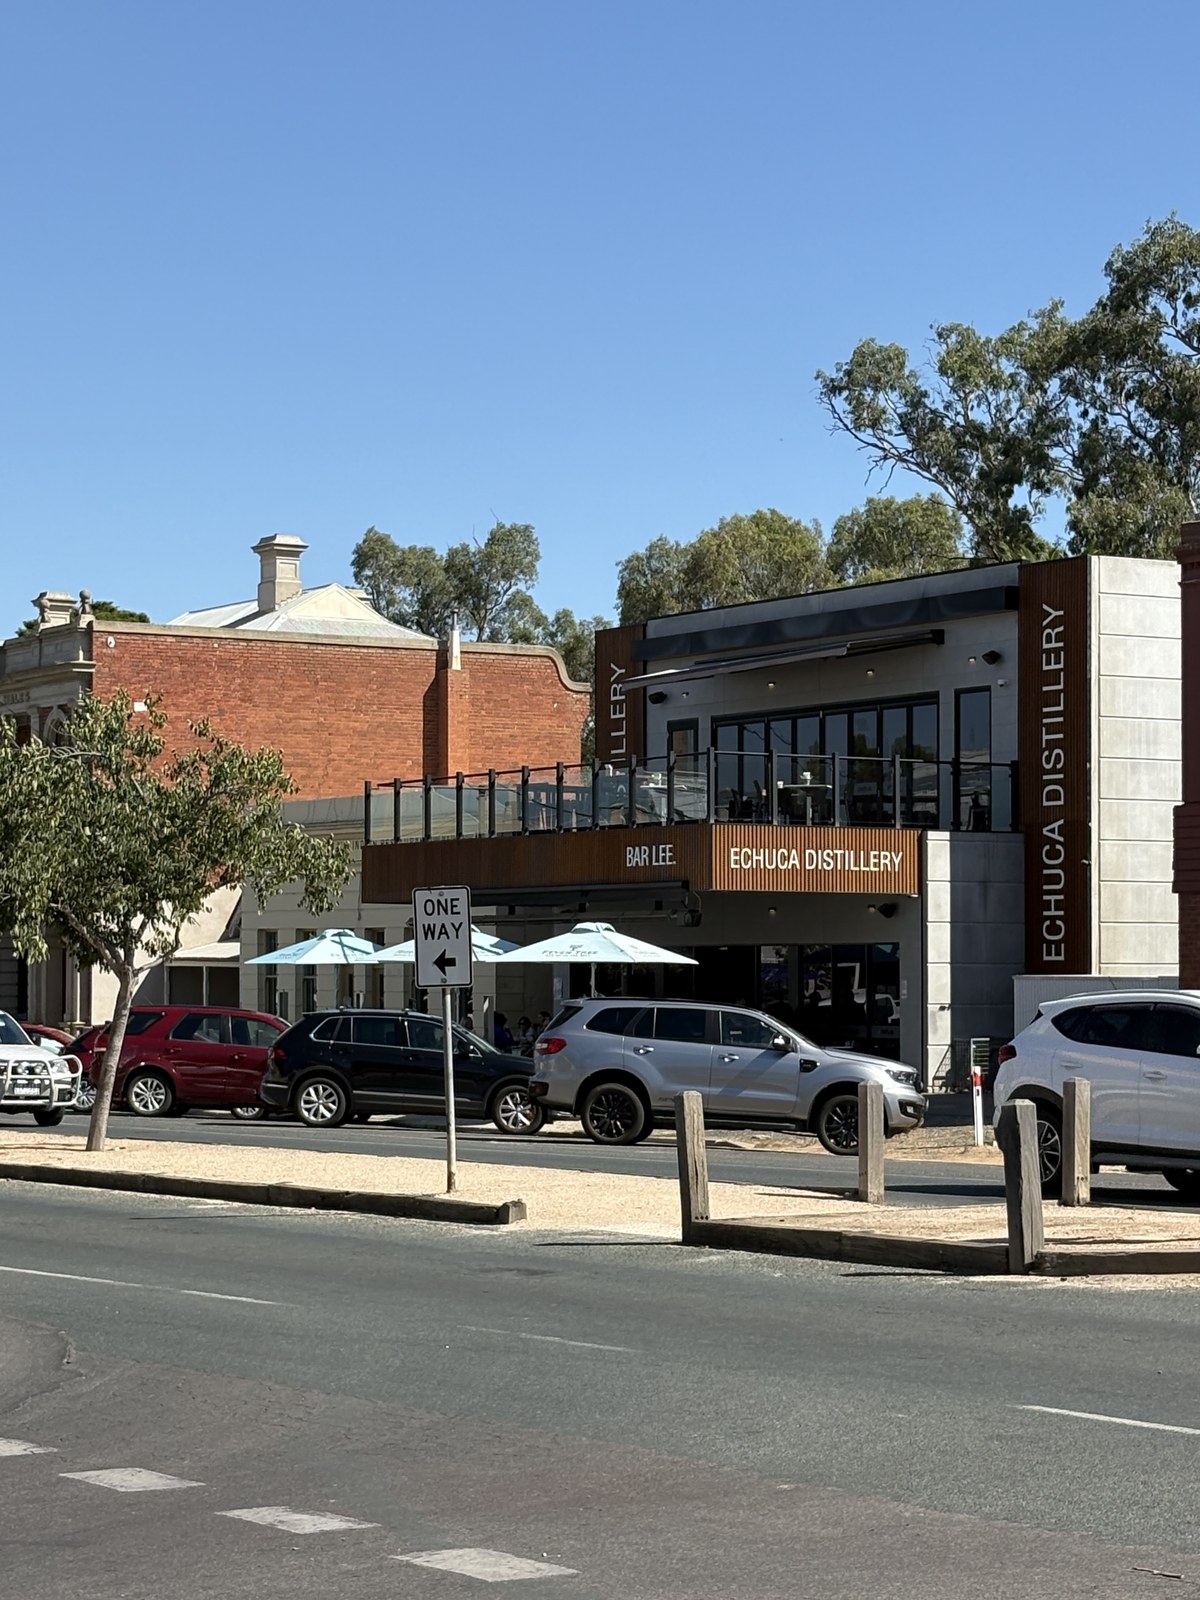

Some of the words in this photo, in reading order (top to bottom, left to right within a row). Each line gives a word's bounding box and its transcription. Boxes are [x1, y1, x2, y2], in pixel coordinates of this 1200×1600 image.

[1042, 603, 1065, 807] DISTILLERY
[626, 846, 649, 867] BAR
[730, 848, 800, 870] ECHUCA
[805, 849, 903, 872] DISTILLERY
[1042, 818, 1065, 961] ECHUCA
[423, 897, 461, 917] ONE
[422, 921, 464, 941] WAY
